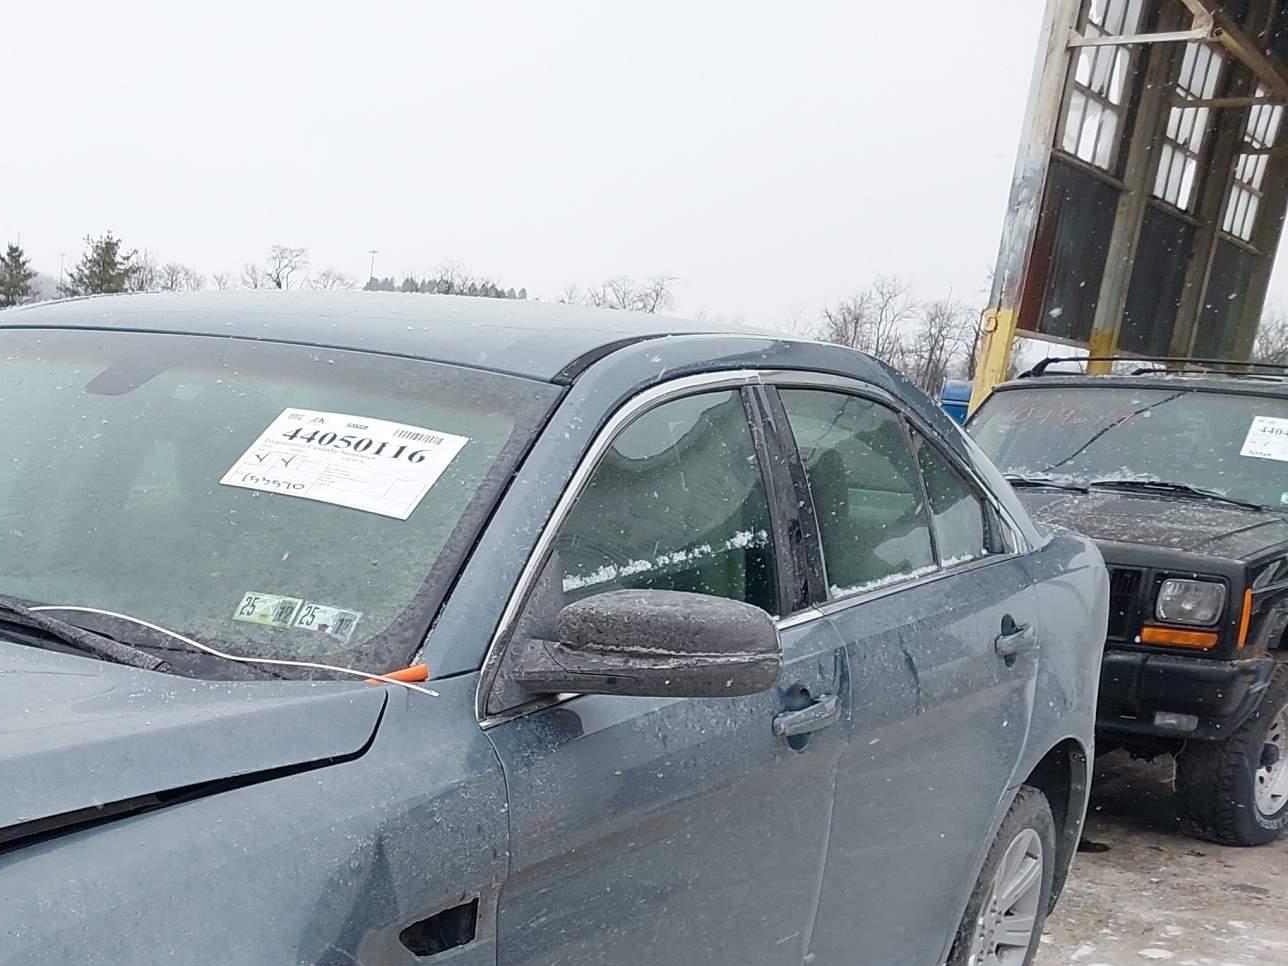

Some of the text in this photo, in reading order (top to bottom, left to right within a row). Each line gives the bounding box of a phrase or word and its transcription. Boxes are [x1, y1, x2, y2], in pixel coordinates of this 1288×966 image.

[282, 427, 433, 464] 44050116
[239, 596, 260, 617] 25
[298, 605, 320, 626] 25
